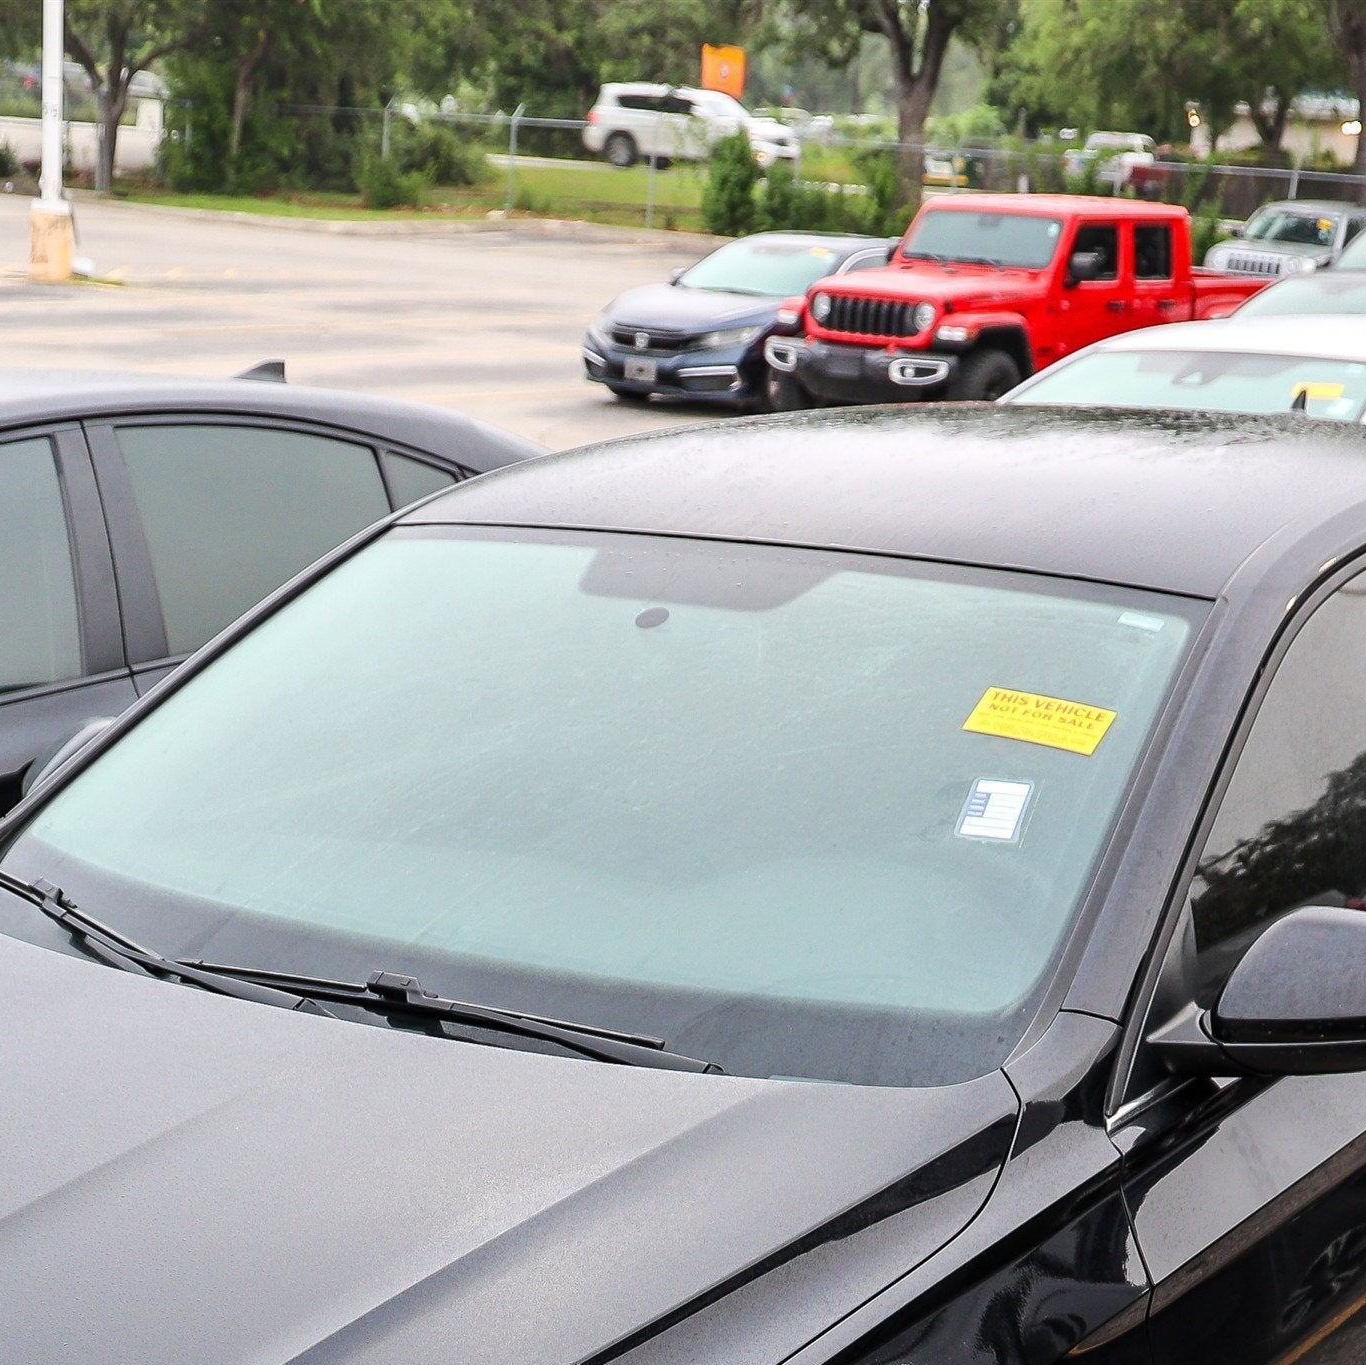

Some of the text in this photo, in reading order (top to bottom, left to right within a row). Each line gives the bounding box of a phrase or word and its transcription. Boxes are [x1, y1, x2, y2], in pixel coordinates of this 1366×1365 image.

[989, 703, 1017, 715] NOT
[1022, 709, 1051, 721] FOR
[1058, 717, 1095, 730] SALE
[992, 691, 1107, 722] THIS VEHICLE
